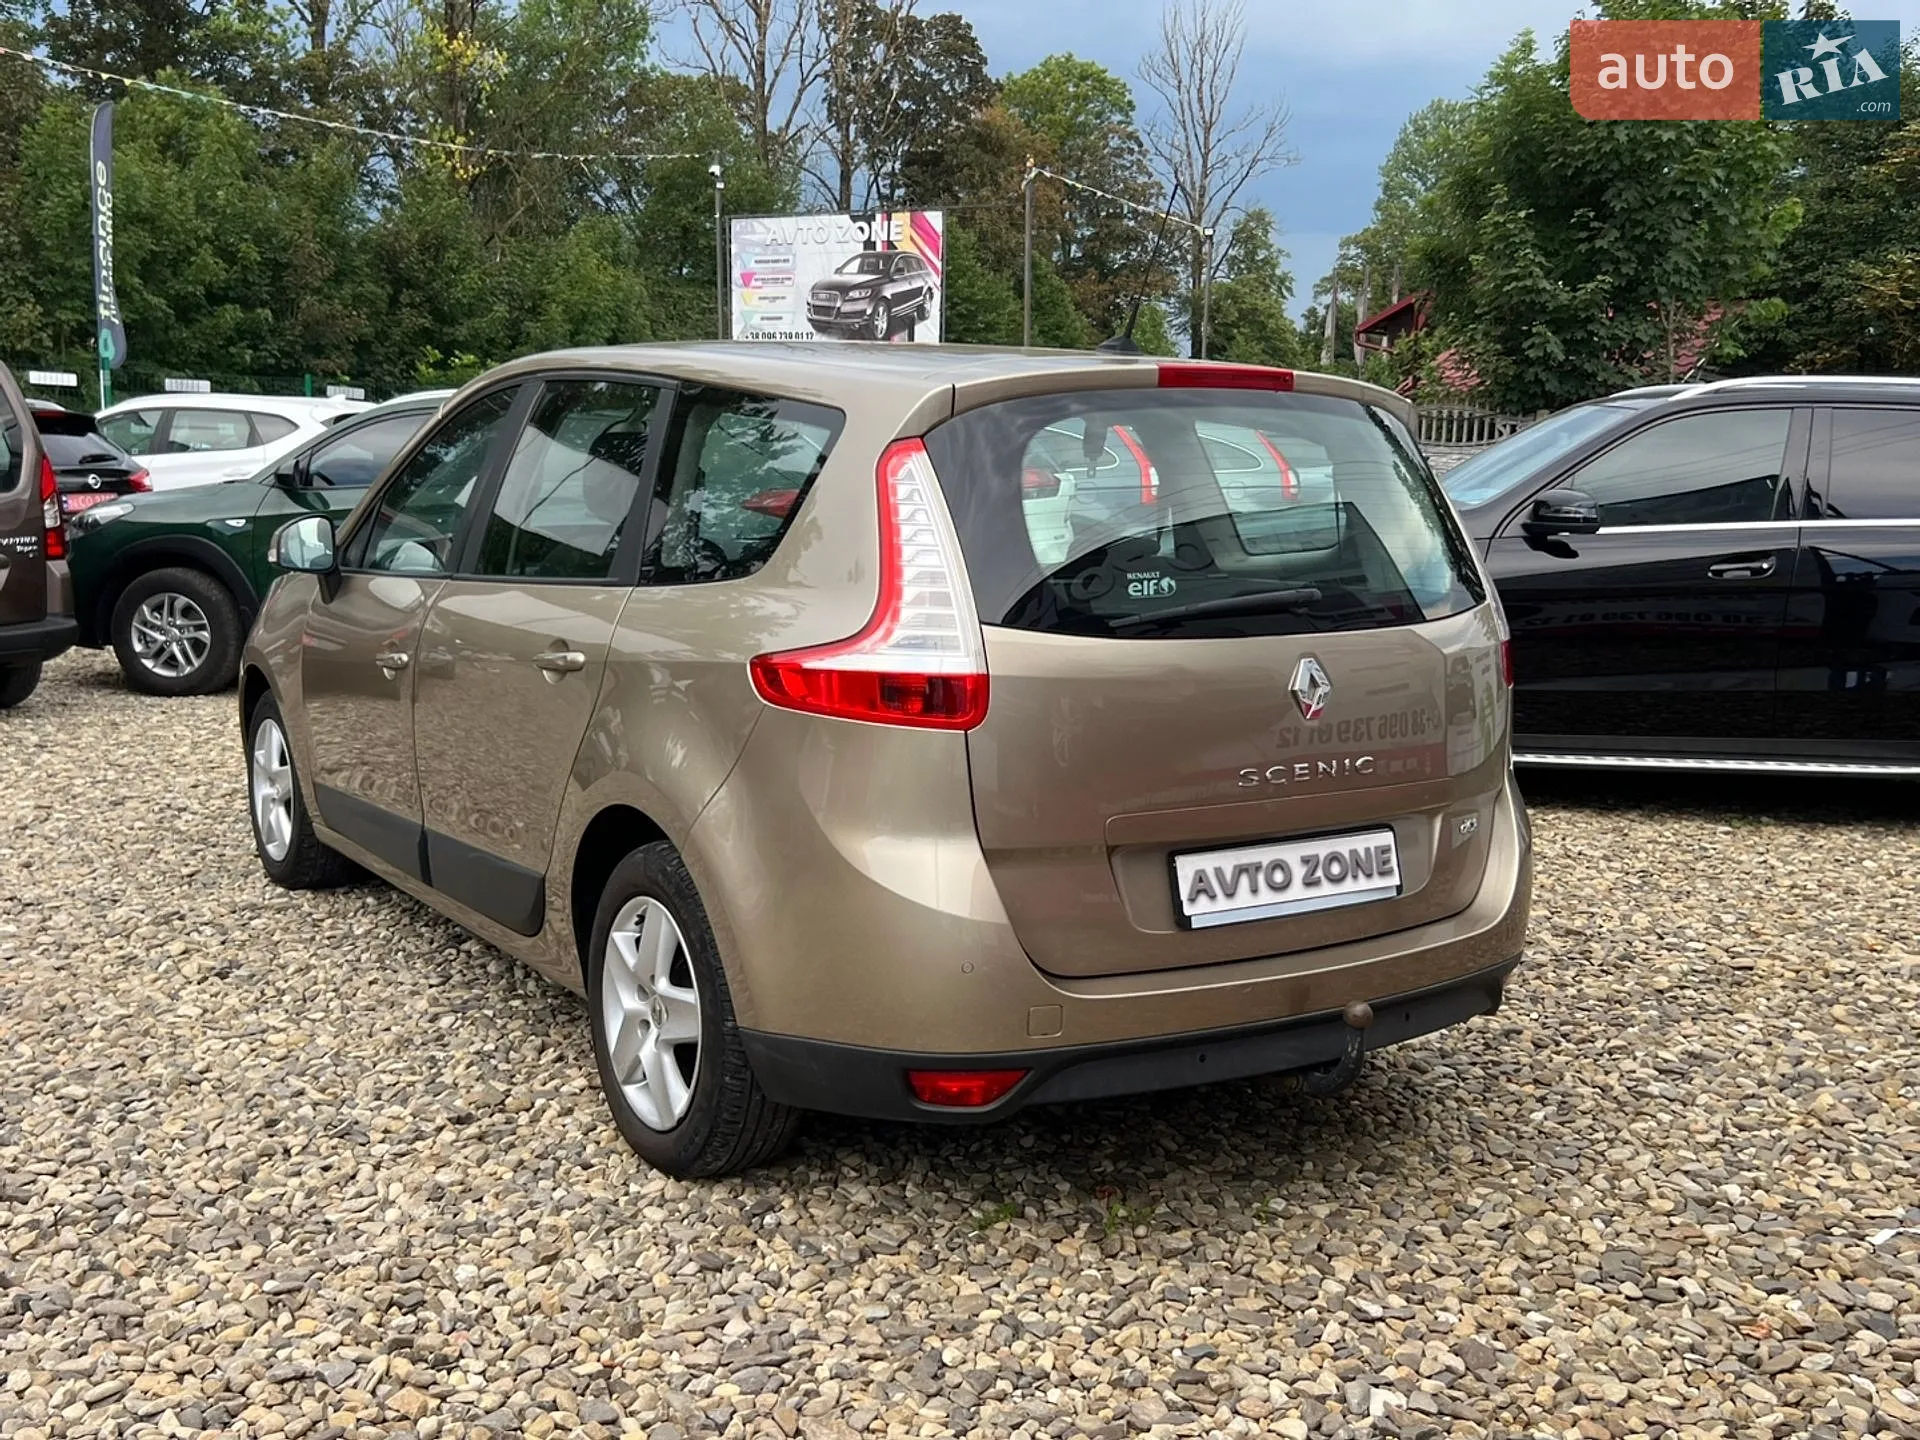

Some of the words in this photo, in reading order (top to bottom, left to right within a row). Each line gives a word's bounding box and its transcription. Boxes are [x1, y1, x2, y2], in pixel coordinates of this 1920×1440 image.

[765, 225, 829, 246] AVTO
[835, 219, 904, 244] ZONE
[1126, 571, 1160, 580] RENAULT
[1128, 580, 1158, 596] elf
[1238, 755, 1375, 788] SCENIC
[1187, 858, 1292, 903] AVTO
[1300, 844, 1395, 887] ZONE
